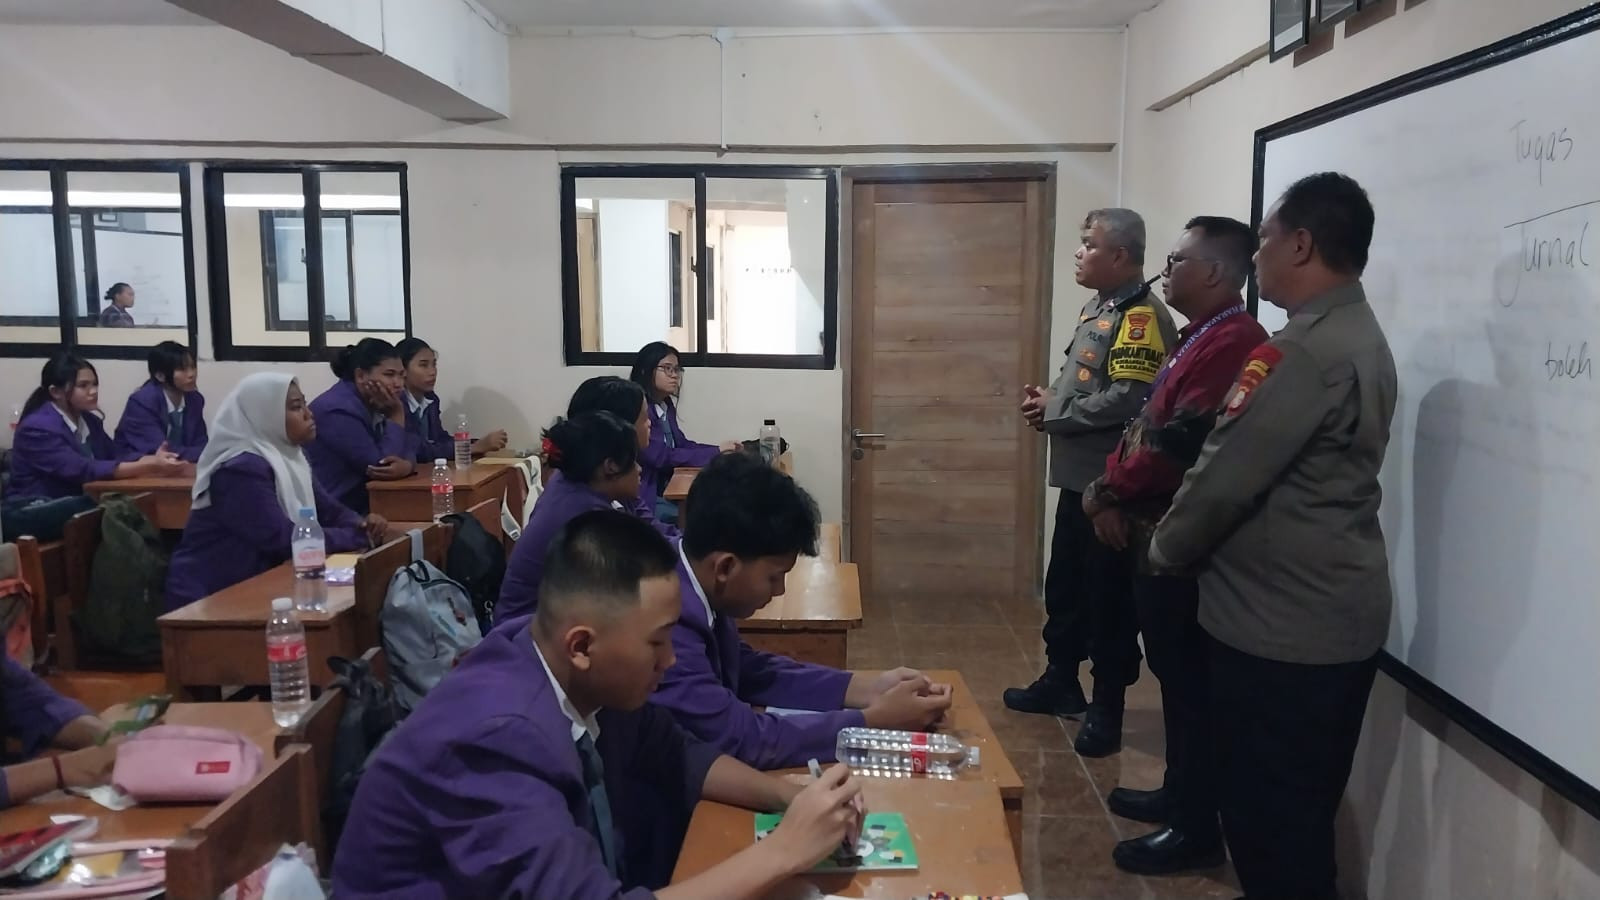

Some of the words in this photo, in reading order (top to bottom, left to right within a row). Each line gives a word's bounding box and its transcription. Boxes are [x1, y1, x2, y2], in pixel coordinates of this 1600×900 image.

[1509, 119, 1574, 187] Tugas
[1498, 220, 1590, 308] Jurnal
[1545, 341, 1592, 381] boleh
